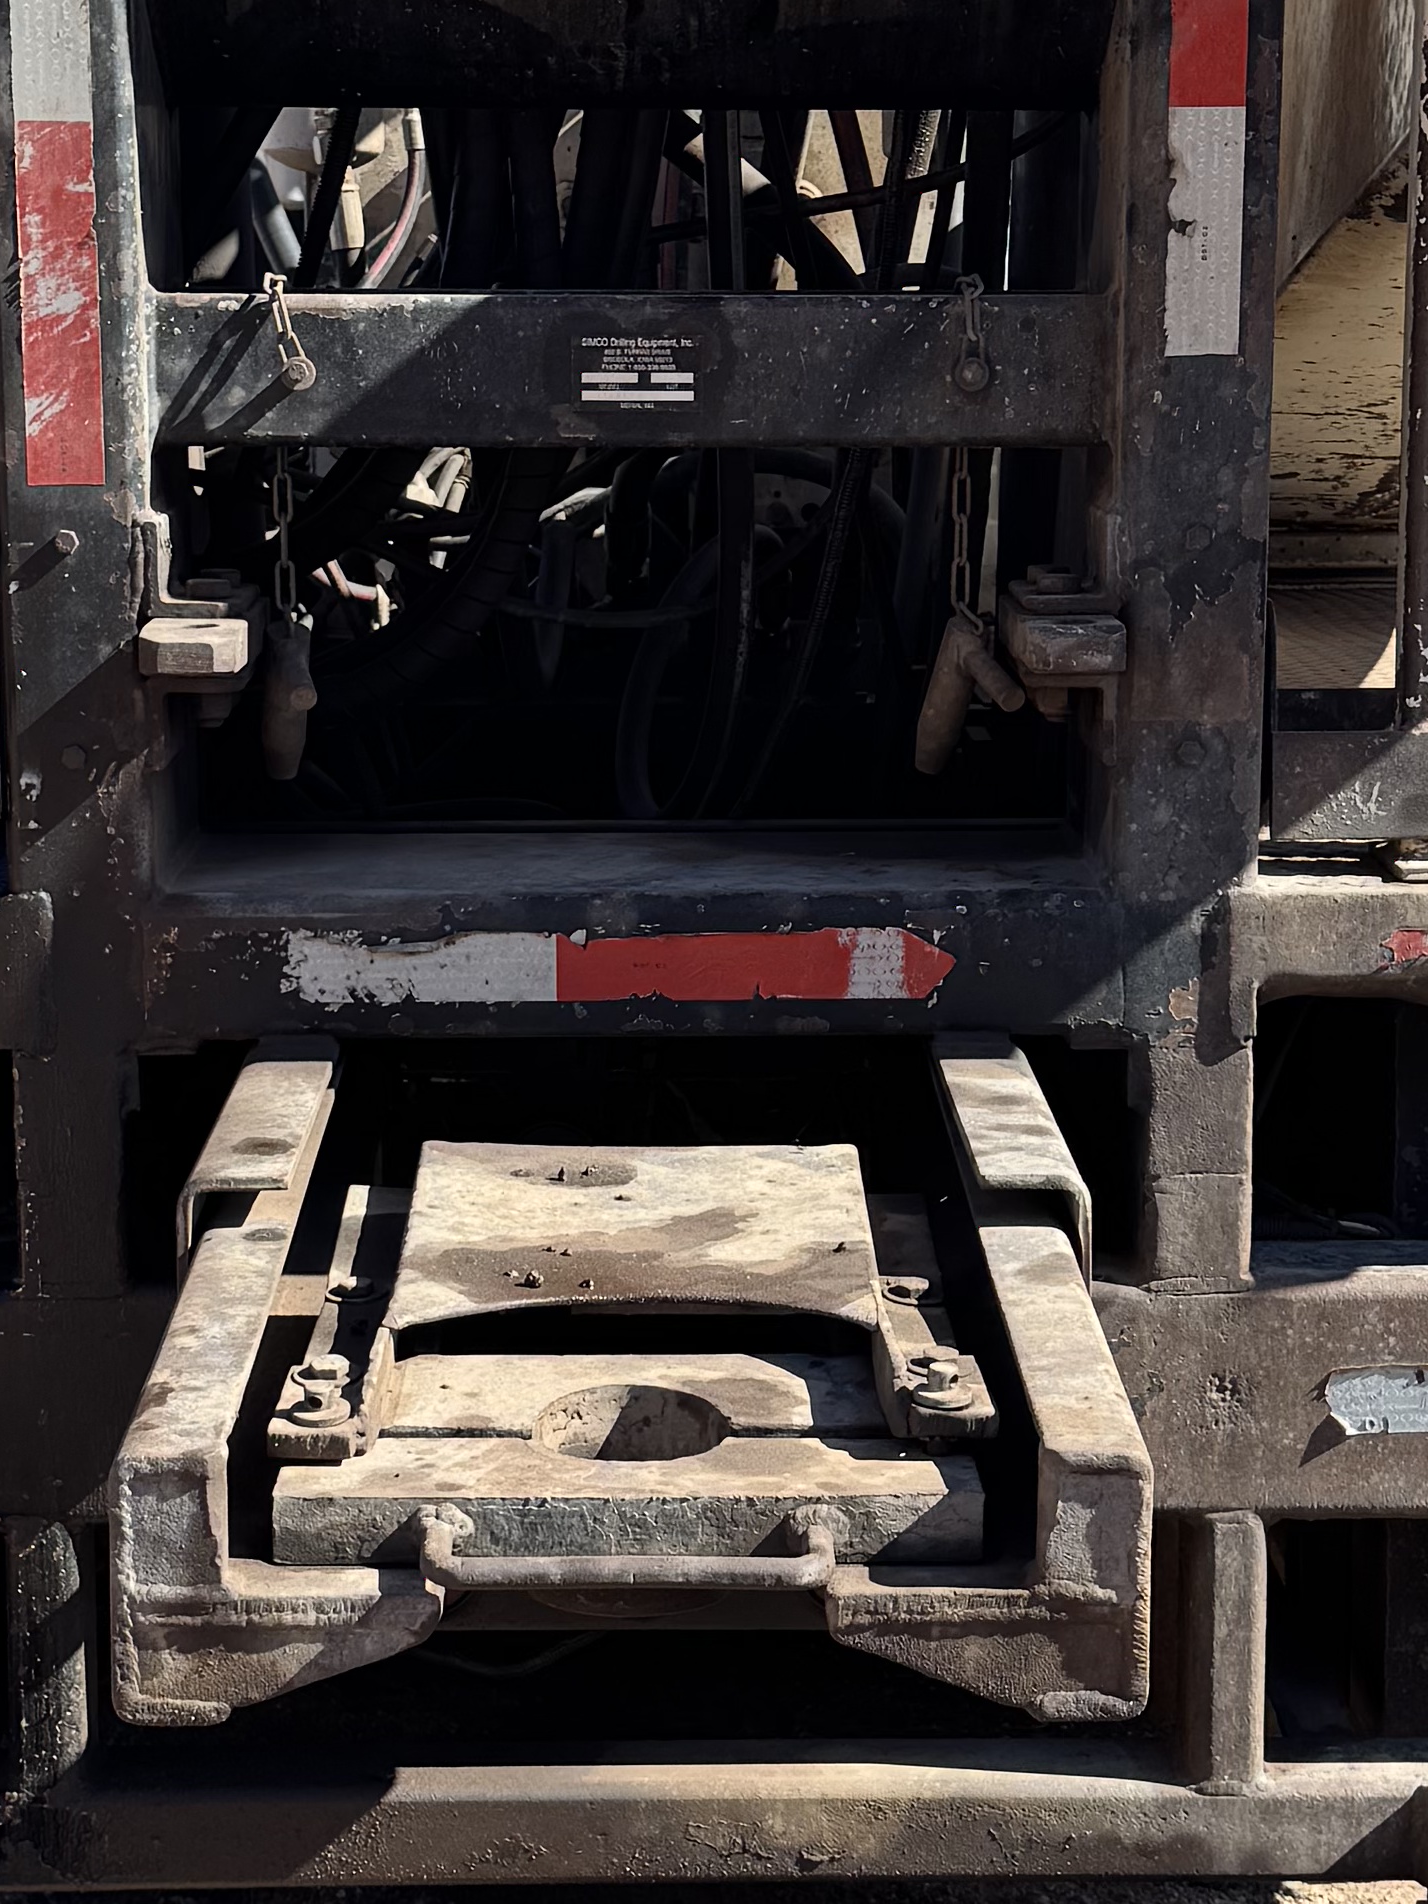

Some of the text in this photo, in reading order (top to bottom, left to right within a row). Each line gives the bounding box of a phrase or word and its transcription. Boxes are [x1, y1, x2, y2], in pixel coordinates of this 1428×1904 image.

[582, 338, 608, 346] SIMCO
[611, 338, 635, 347] Drilling
[681, 339, 694, 347] Inc.
